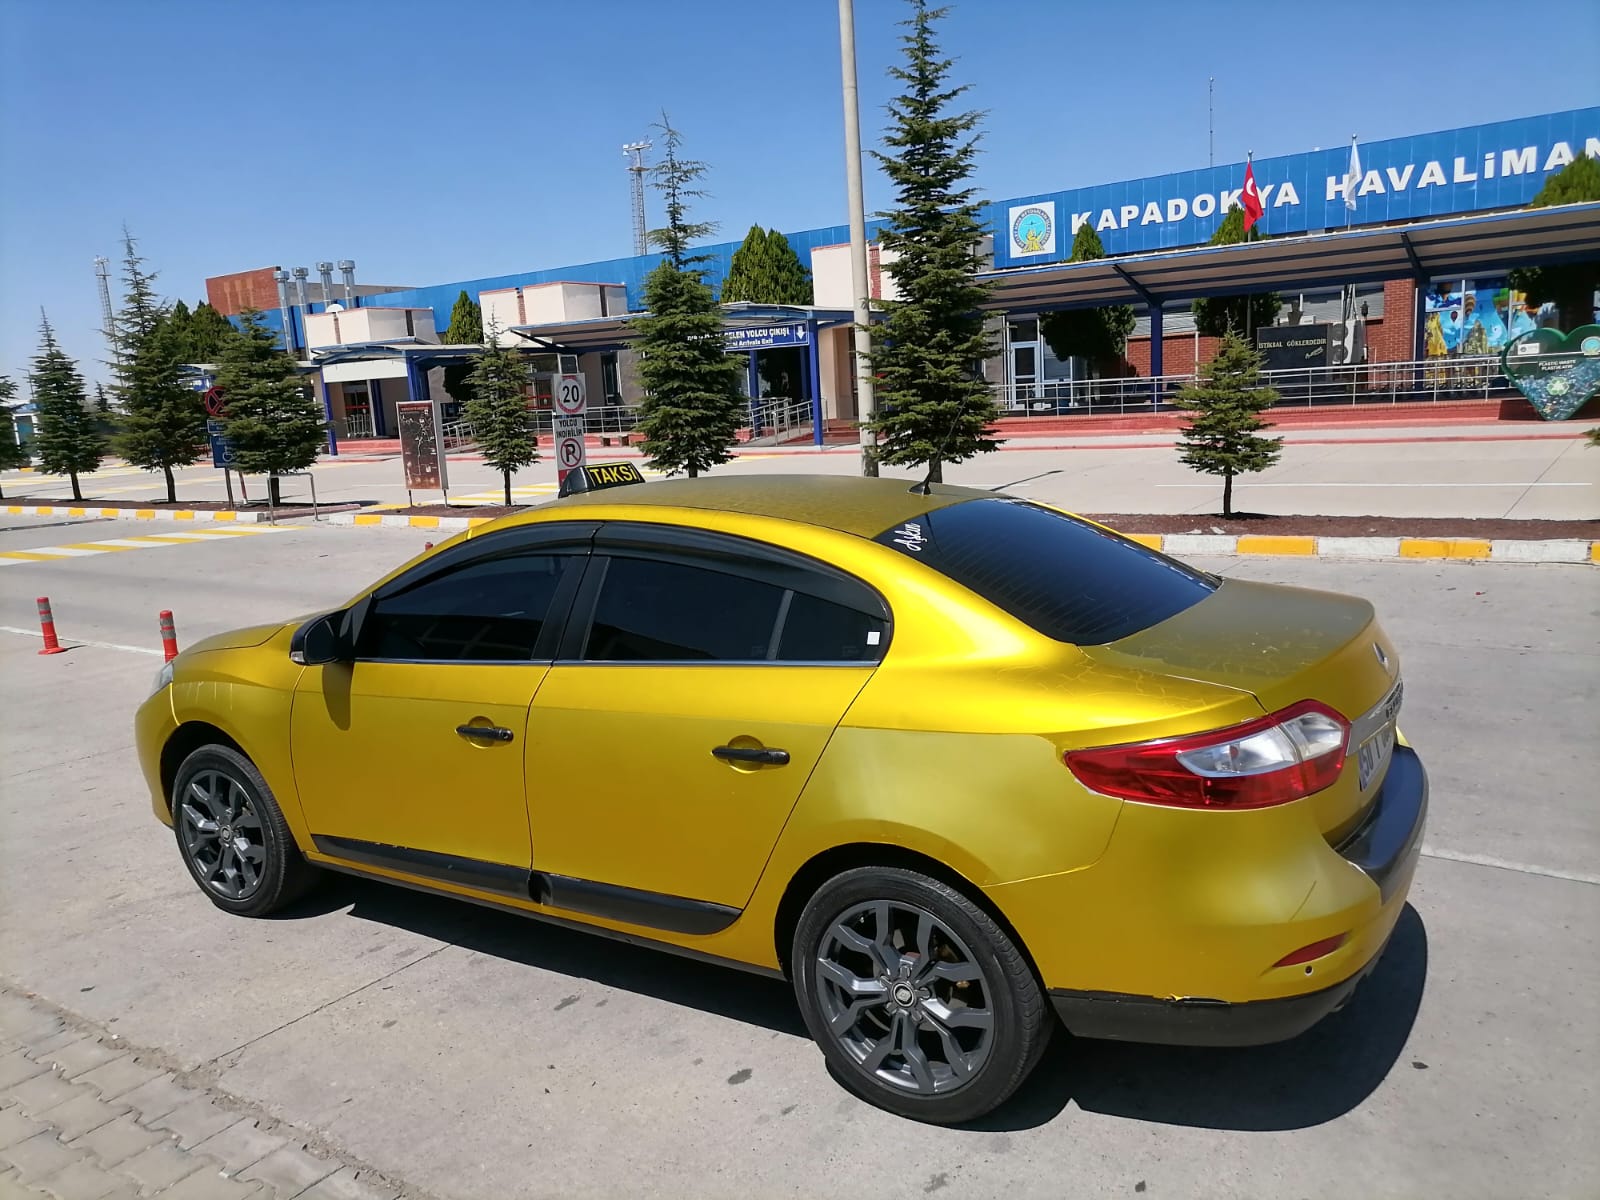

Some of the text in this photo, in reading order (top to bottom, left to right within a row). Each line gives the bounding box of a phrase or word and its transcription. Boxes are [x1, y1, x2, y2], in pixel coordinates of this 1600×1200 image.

[1071, 181, 1300, 236] KAPADOKYA
[562, 385, 579, 403] 20
[589, 465, 637, 484] TAKSİ
